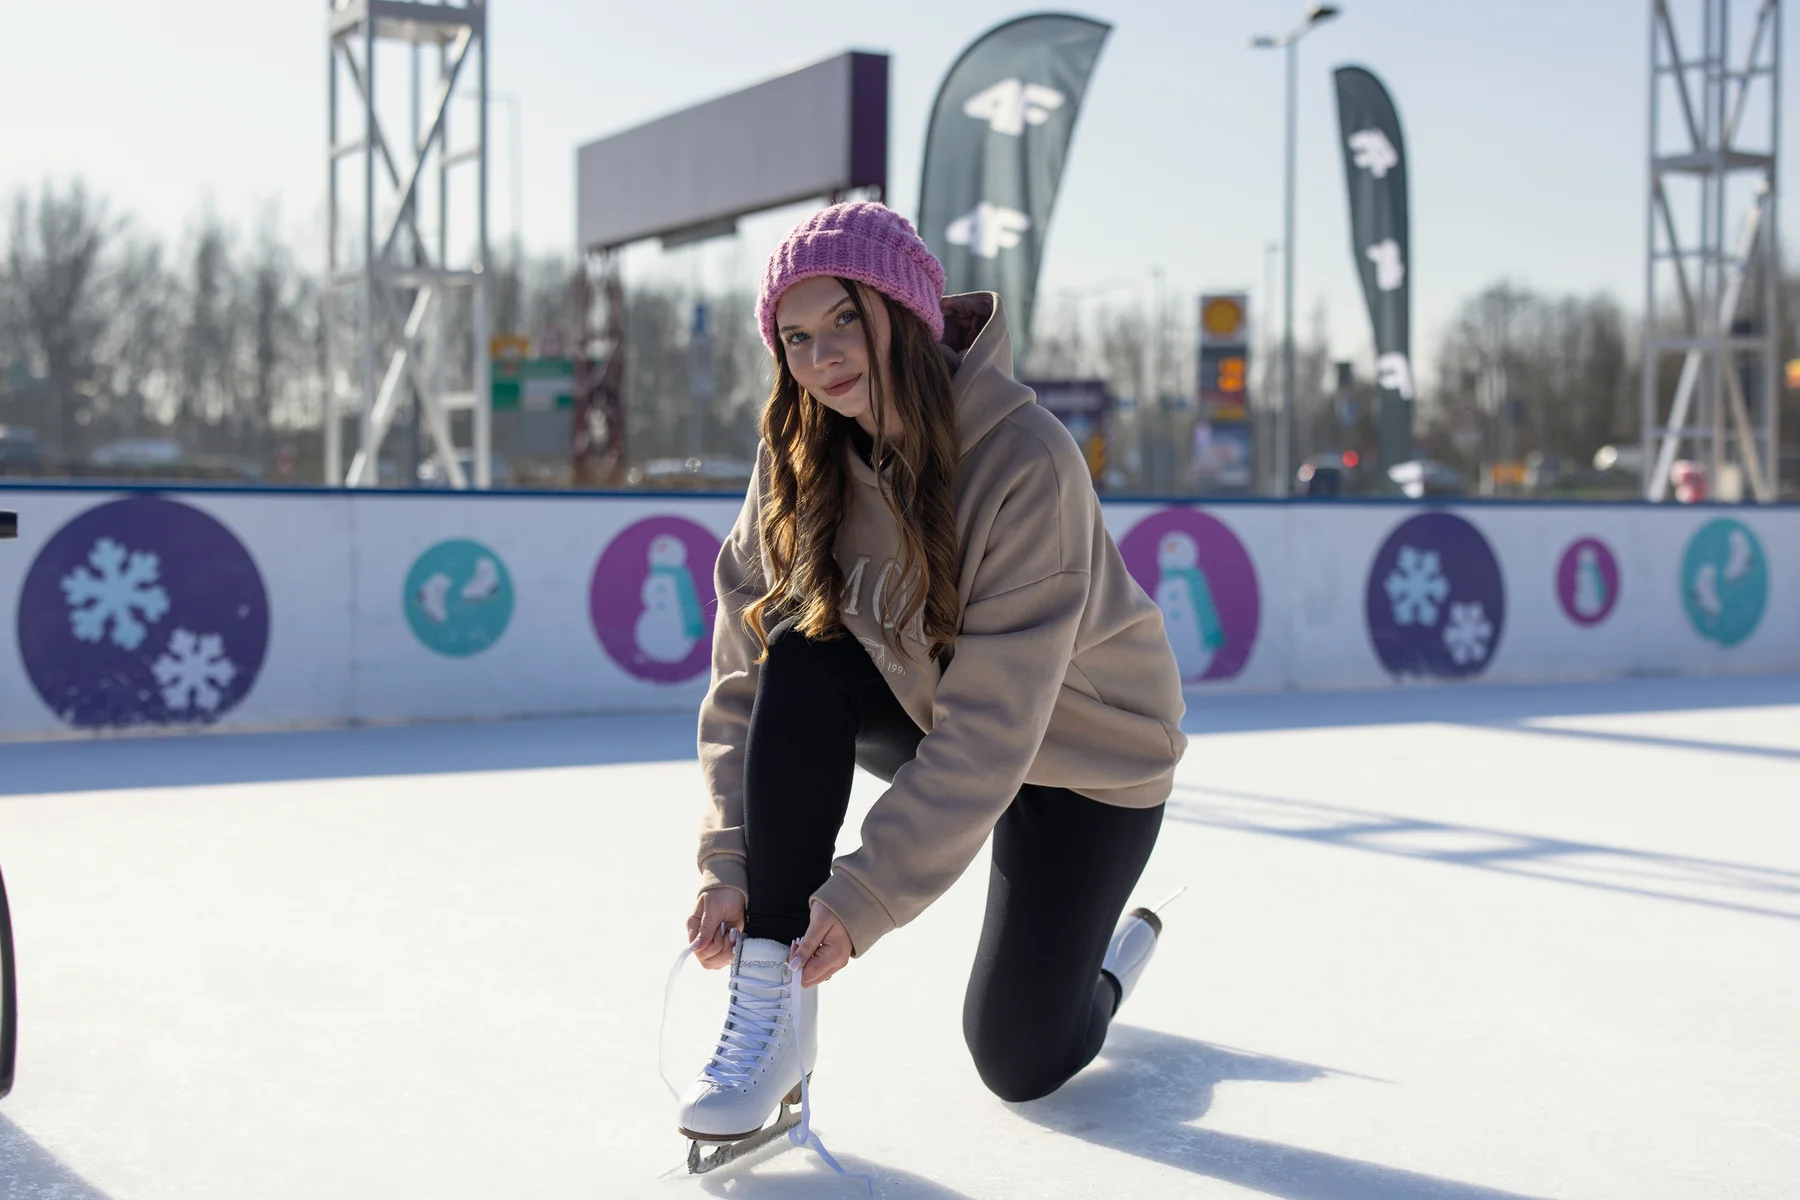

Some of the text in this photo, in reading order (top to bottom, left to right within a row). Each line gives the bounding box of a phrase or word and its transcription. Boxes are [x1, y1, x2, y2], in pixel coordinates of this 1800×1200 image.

[963, 77, 1065, 136] 4F
[945, 201, 1030, 259] 4F
[739, 960, 785, 969] EMPISH
